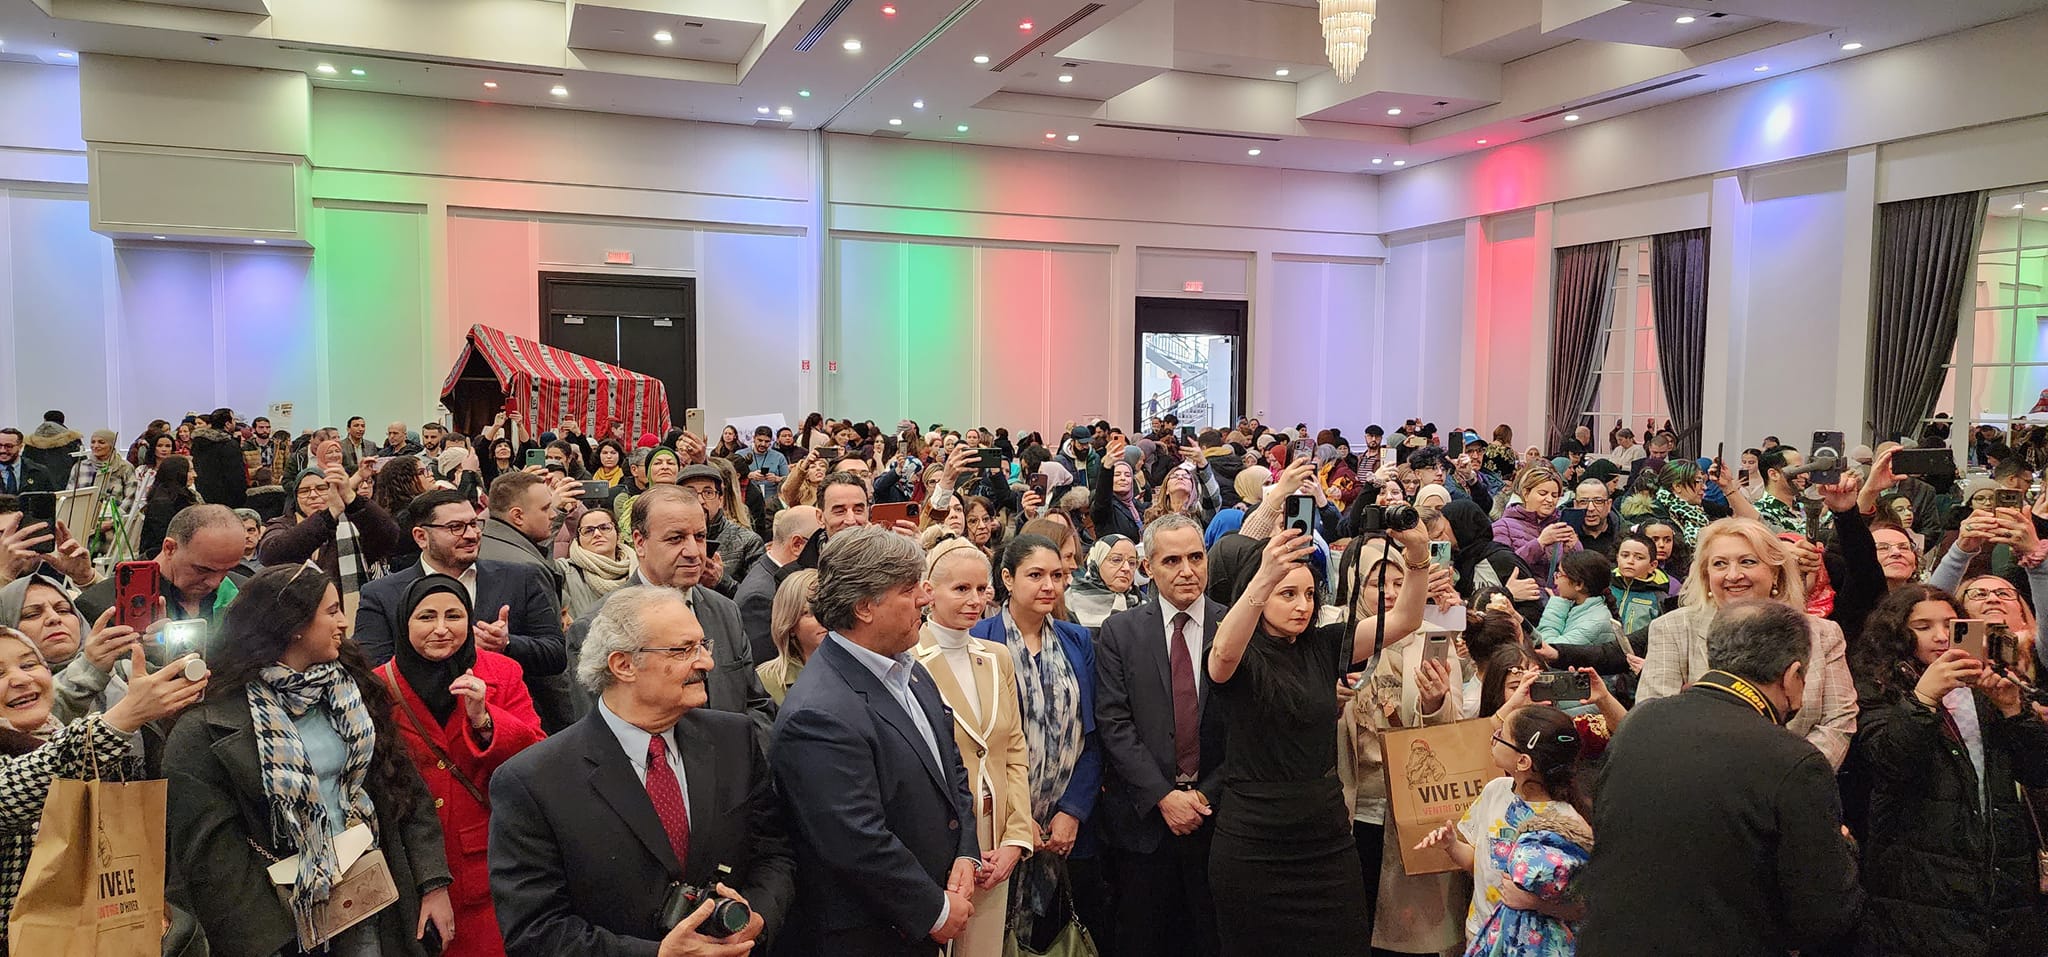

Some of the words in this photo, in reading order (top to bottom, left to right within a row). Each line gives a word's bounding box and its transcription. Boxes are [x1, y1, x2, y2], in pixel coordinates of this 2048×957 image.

[1730, 681, 1765, 709] Nikon
[1418, 782, 1461, 803] VIVE
[1464, 779, 1483, 797] LE
[97, 870, 123, 899] IVE
[123, 868, 136, 894] LE
